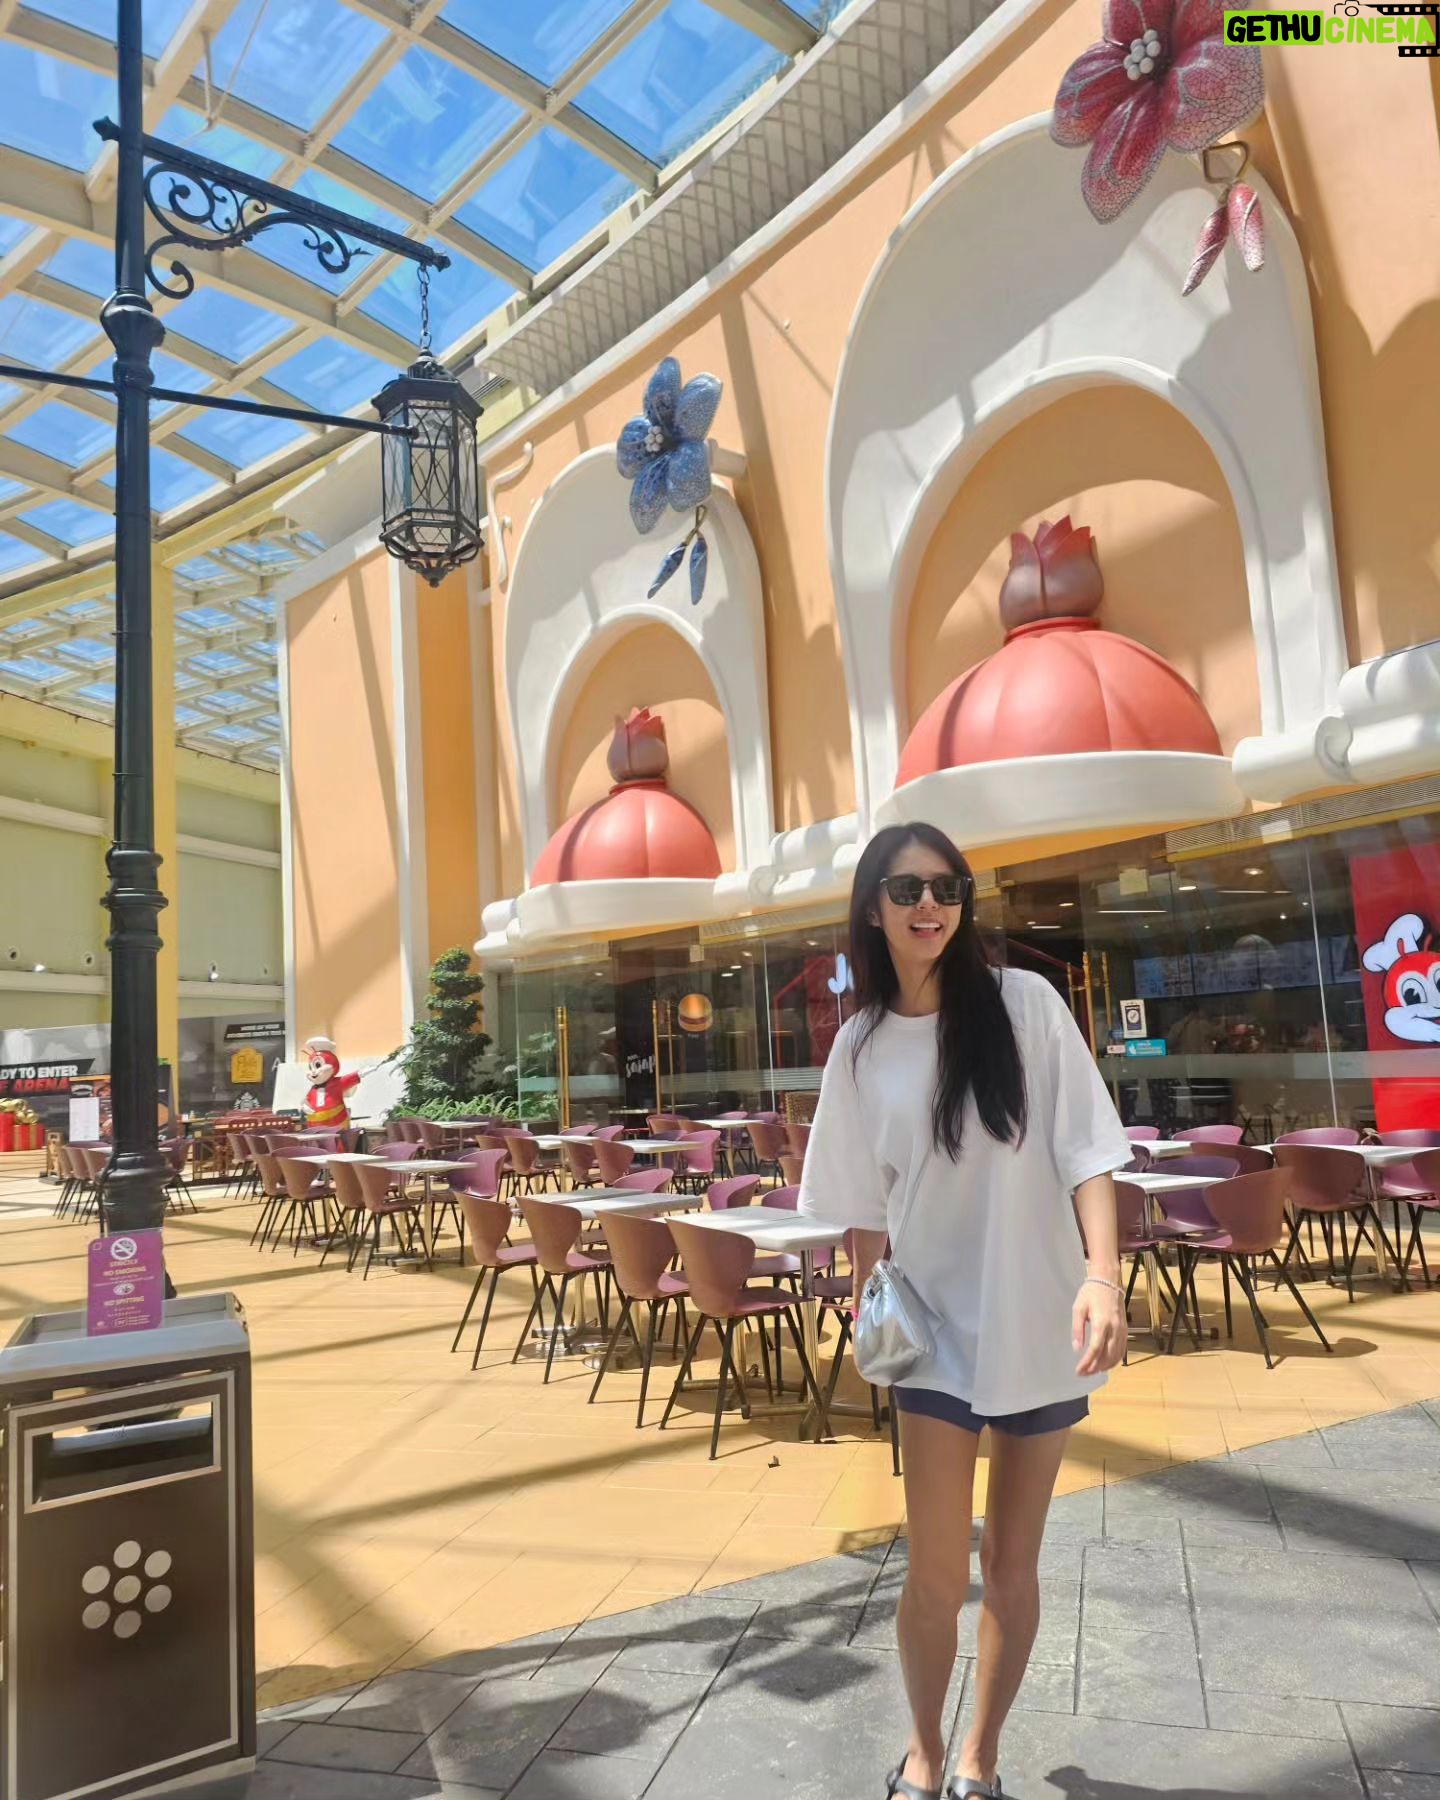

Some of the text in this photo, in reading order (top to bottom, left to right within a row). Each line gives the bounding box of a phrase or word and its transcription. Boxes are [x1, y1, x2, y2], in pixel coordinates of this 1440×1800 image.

[0, 1065, 78, 1080] DY TO ENTER
[13, 1077, 69, 1091] ARENA
